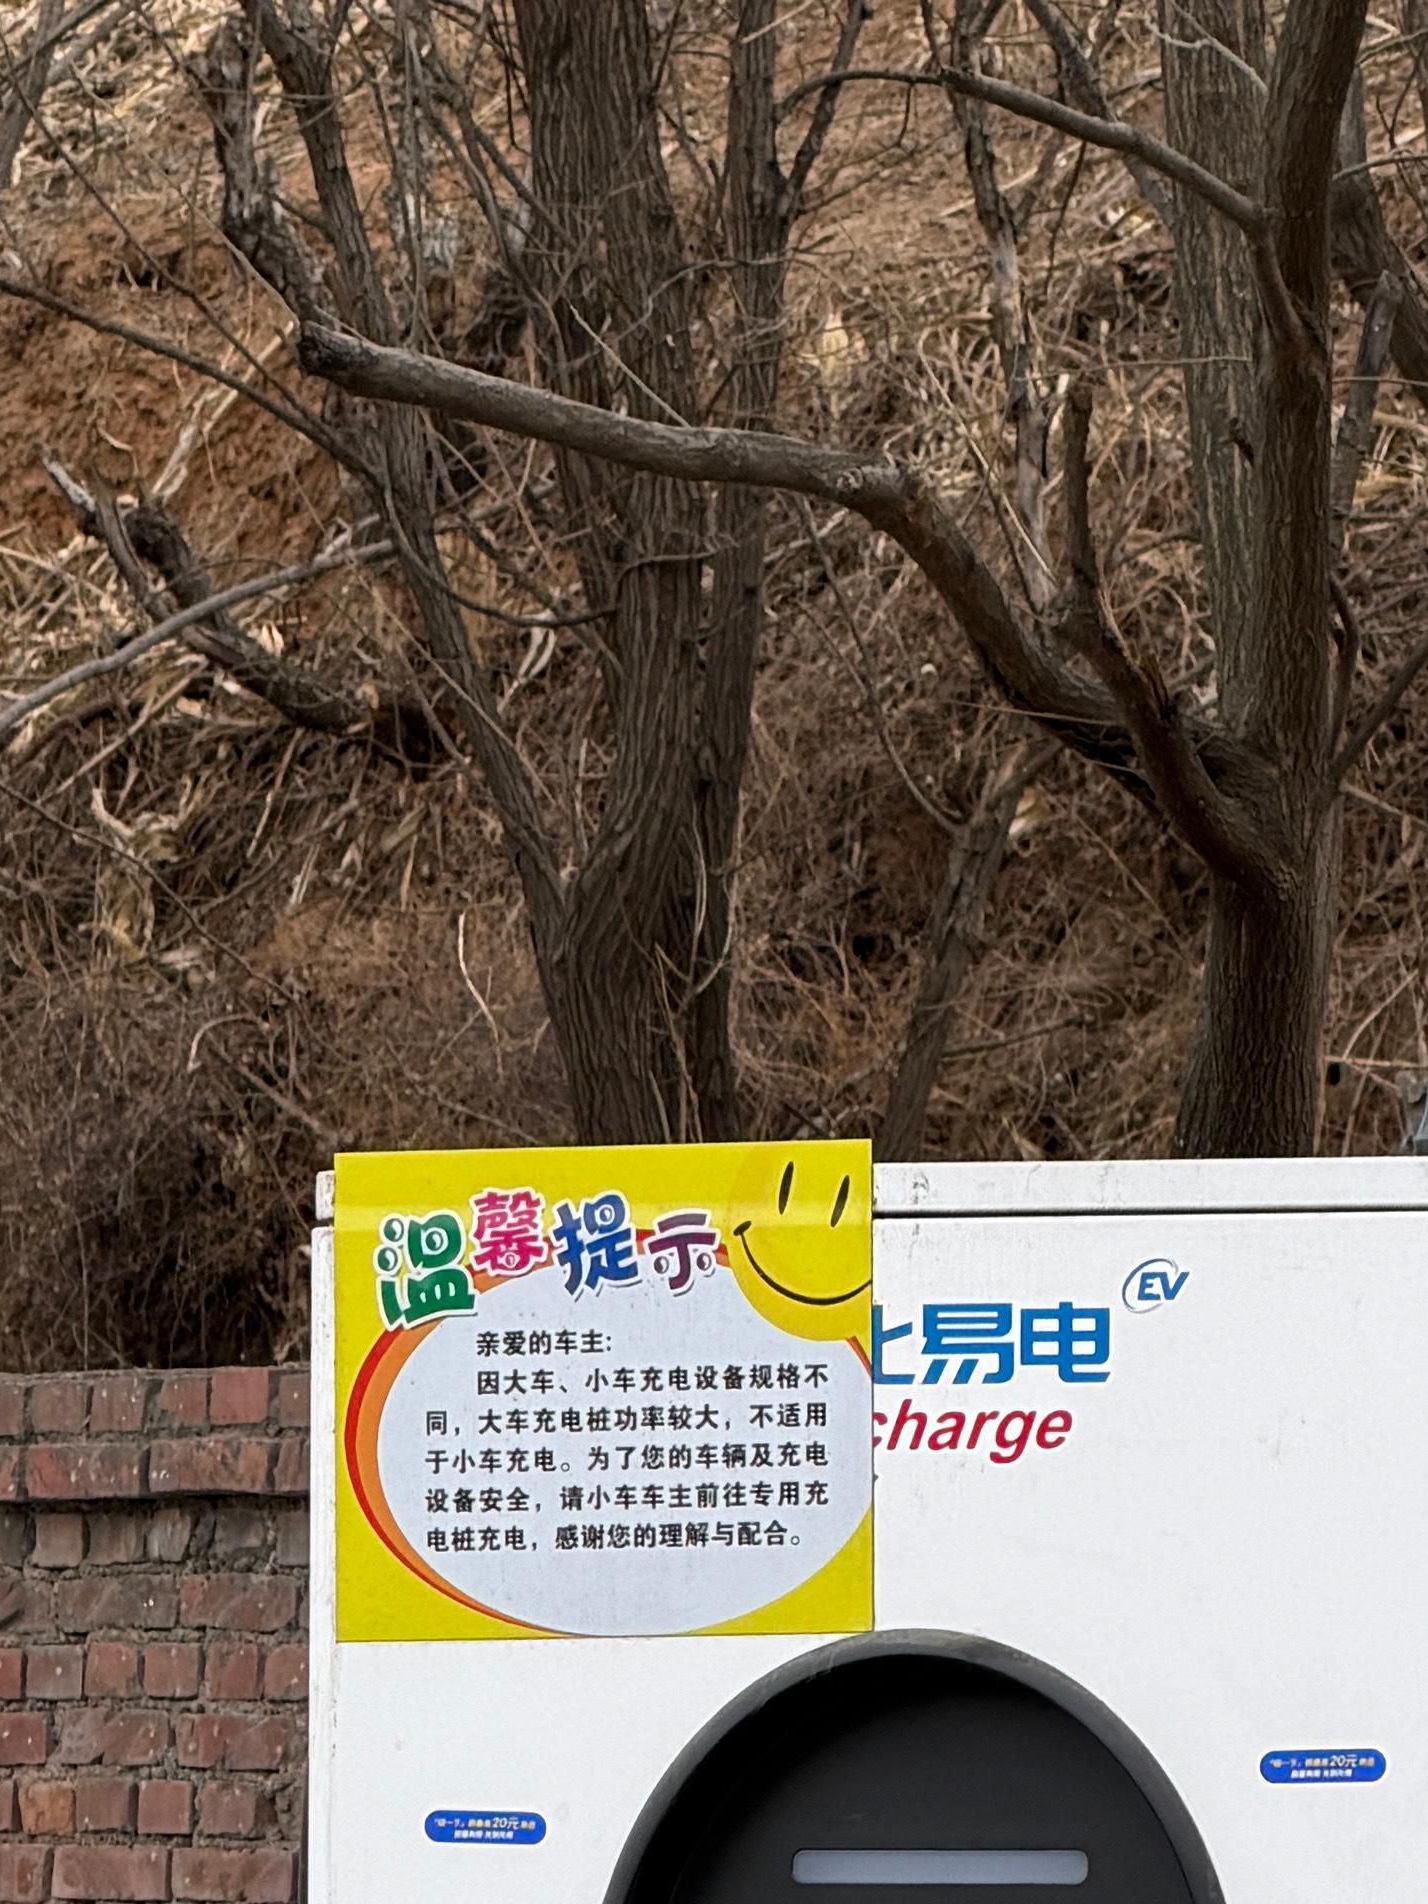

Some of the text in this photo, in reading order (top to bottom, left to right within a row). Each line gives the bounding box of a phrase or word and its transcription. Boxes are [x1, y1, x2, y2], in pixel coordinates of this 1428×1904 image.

[376, 1189, 718, 1327] 温馨提示
[1137, 1271, 1190, 1301] EV
[476, 1329, 612, 1356] 亲爱的车主：
[476, 1362, 829, 1396] 因大车、小车充电设备规格不
[425, 1401, 828, 1437] 同，大车充电桩功率较大，不适用
[425, 1440, 829, 1474] 于小车充电。为了您的车辆及充电
[425, 1479, 829, 1514] 设备安全，请小车车主前往专用充
[426, 1518, 802, 1553] 电桩充电，感谢您的理解与配合。
